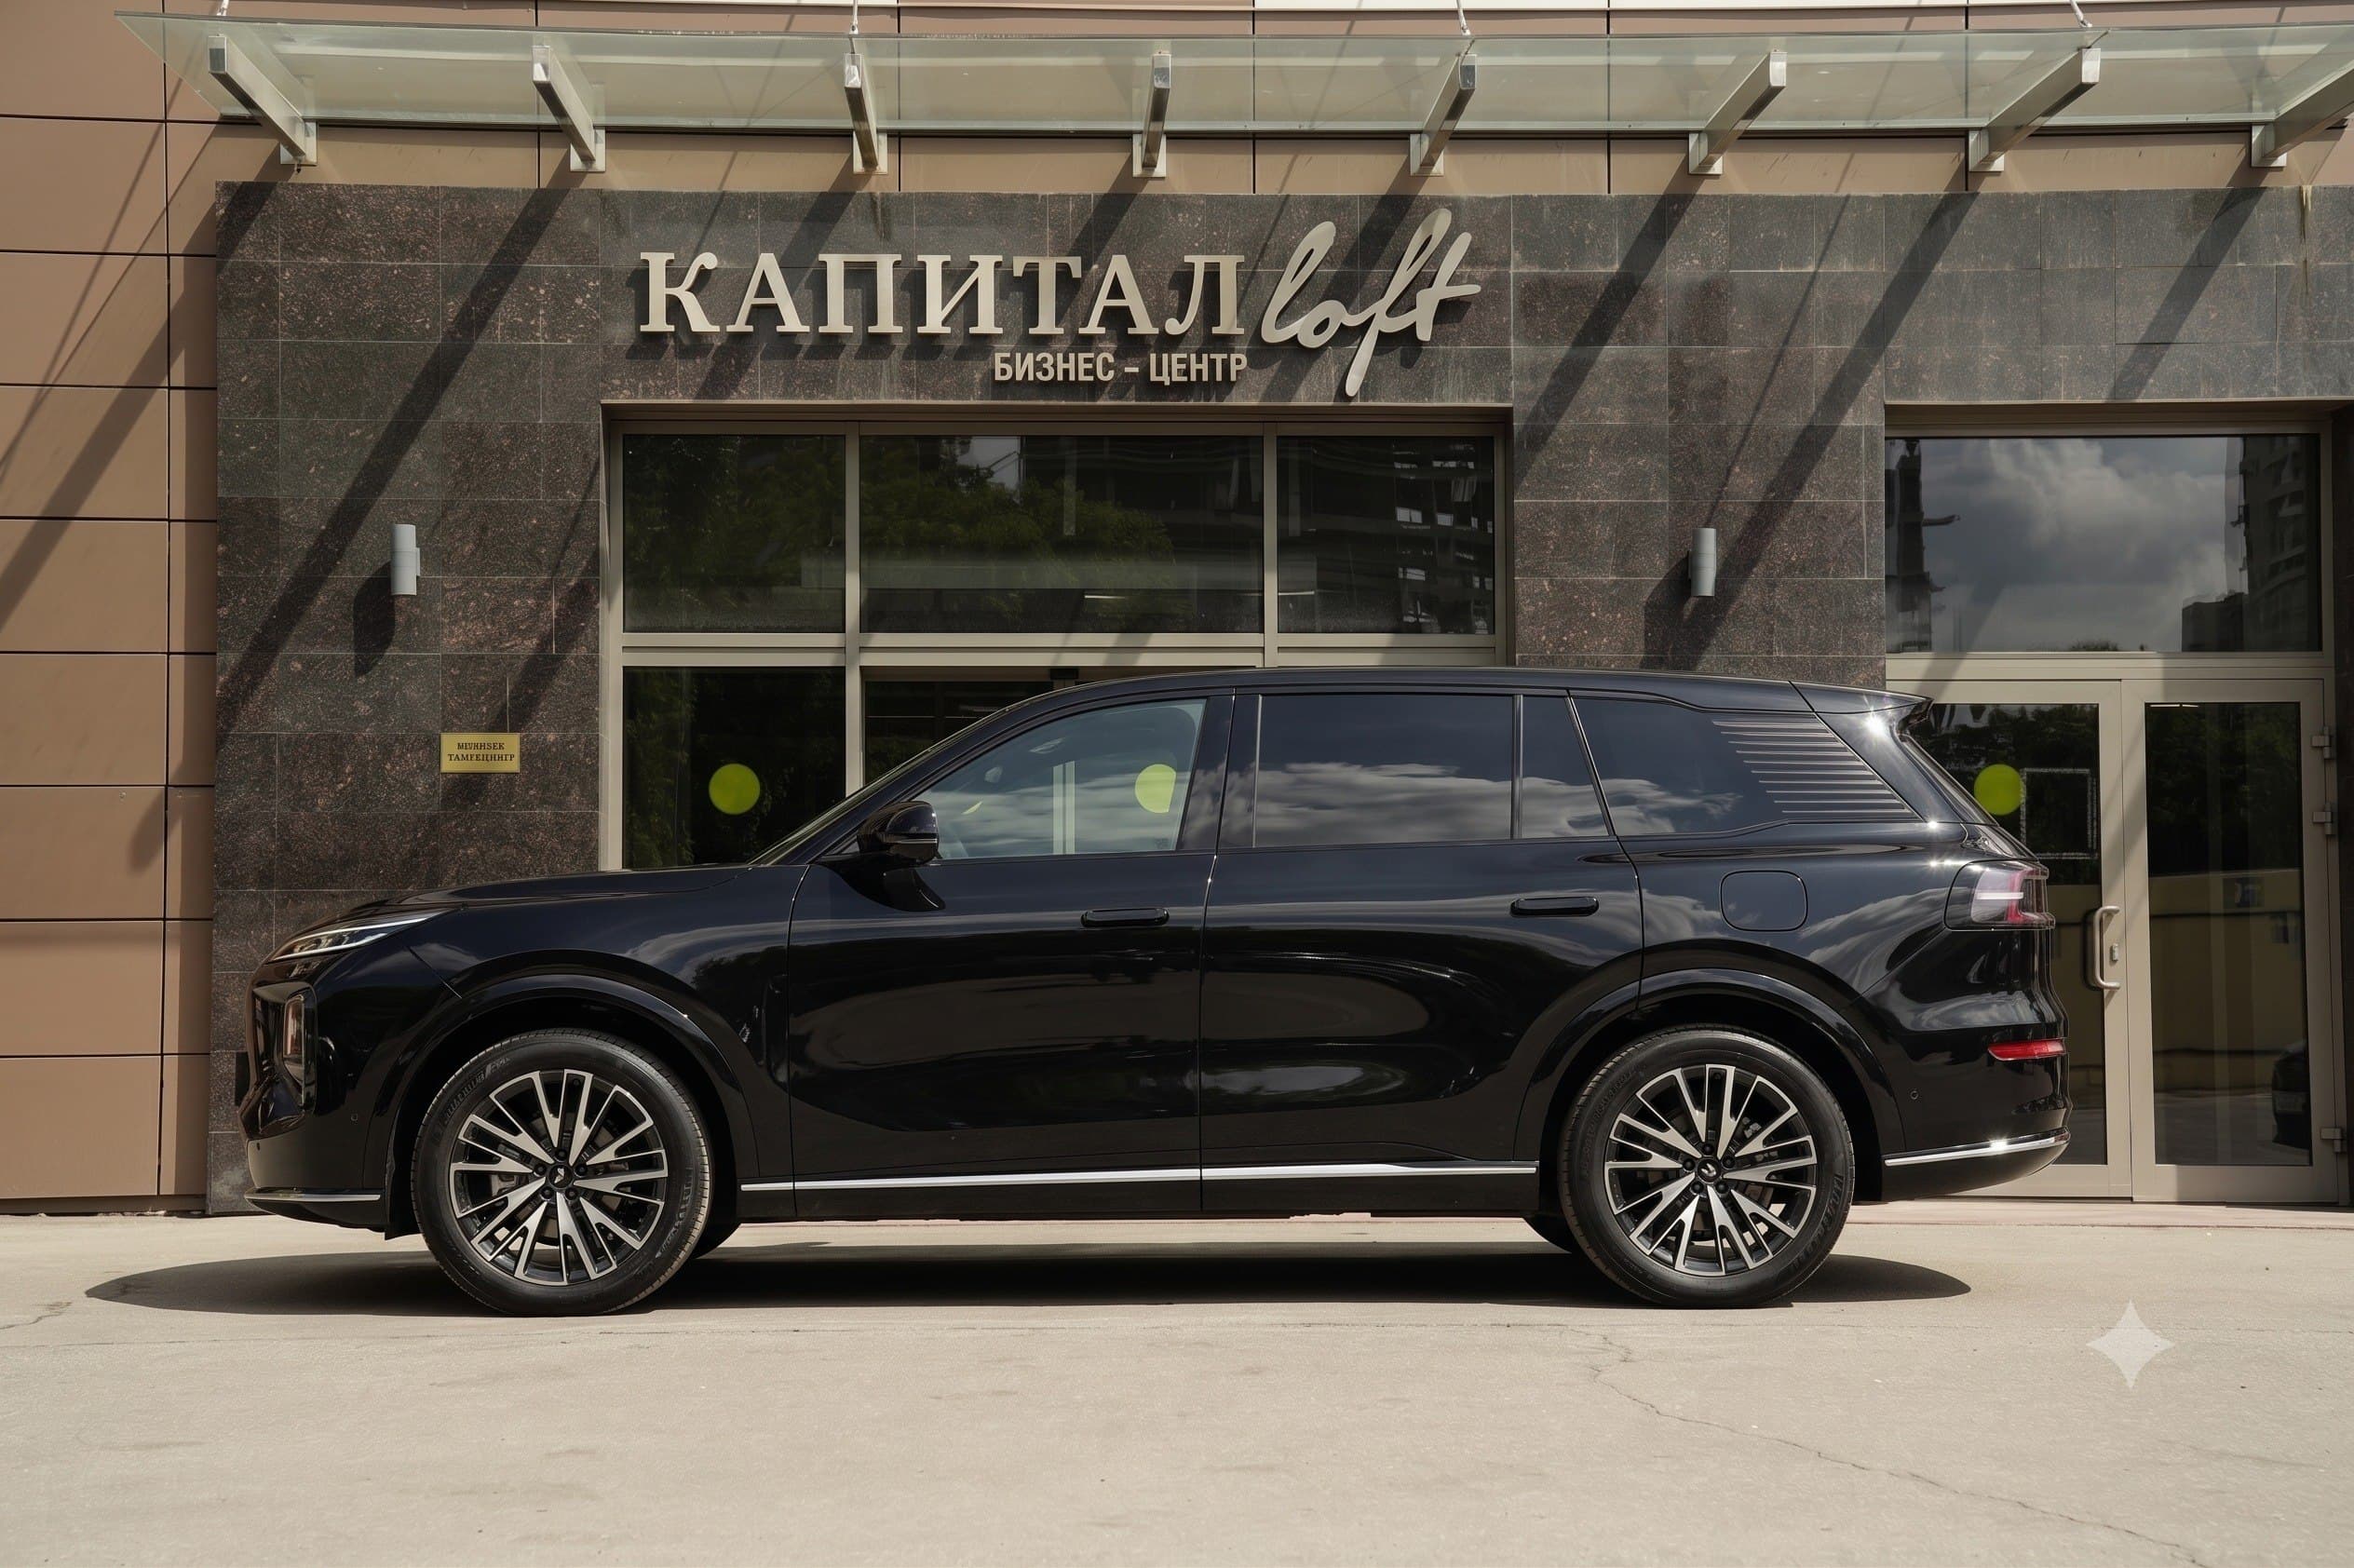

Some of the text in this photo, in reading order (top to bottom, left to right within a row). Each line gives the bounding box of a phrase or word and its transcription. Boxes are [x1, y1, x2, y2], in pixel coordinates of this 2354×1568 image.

[641, 252, 1245, 334] КАПИТАЛ
[1261, 208, 1481, 397] loft
[994, 352, 1115, 382] БИЗНЕС
[1149, 353, 1248, 385] ЦЕНТР
